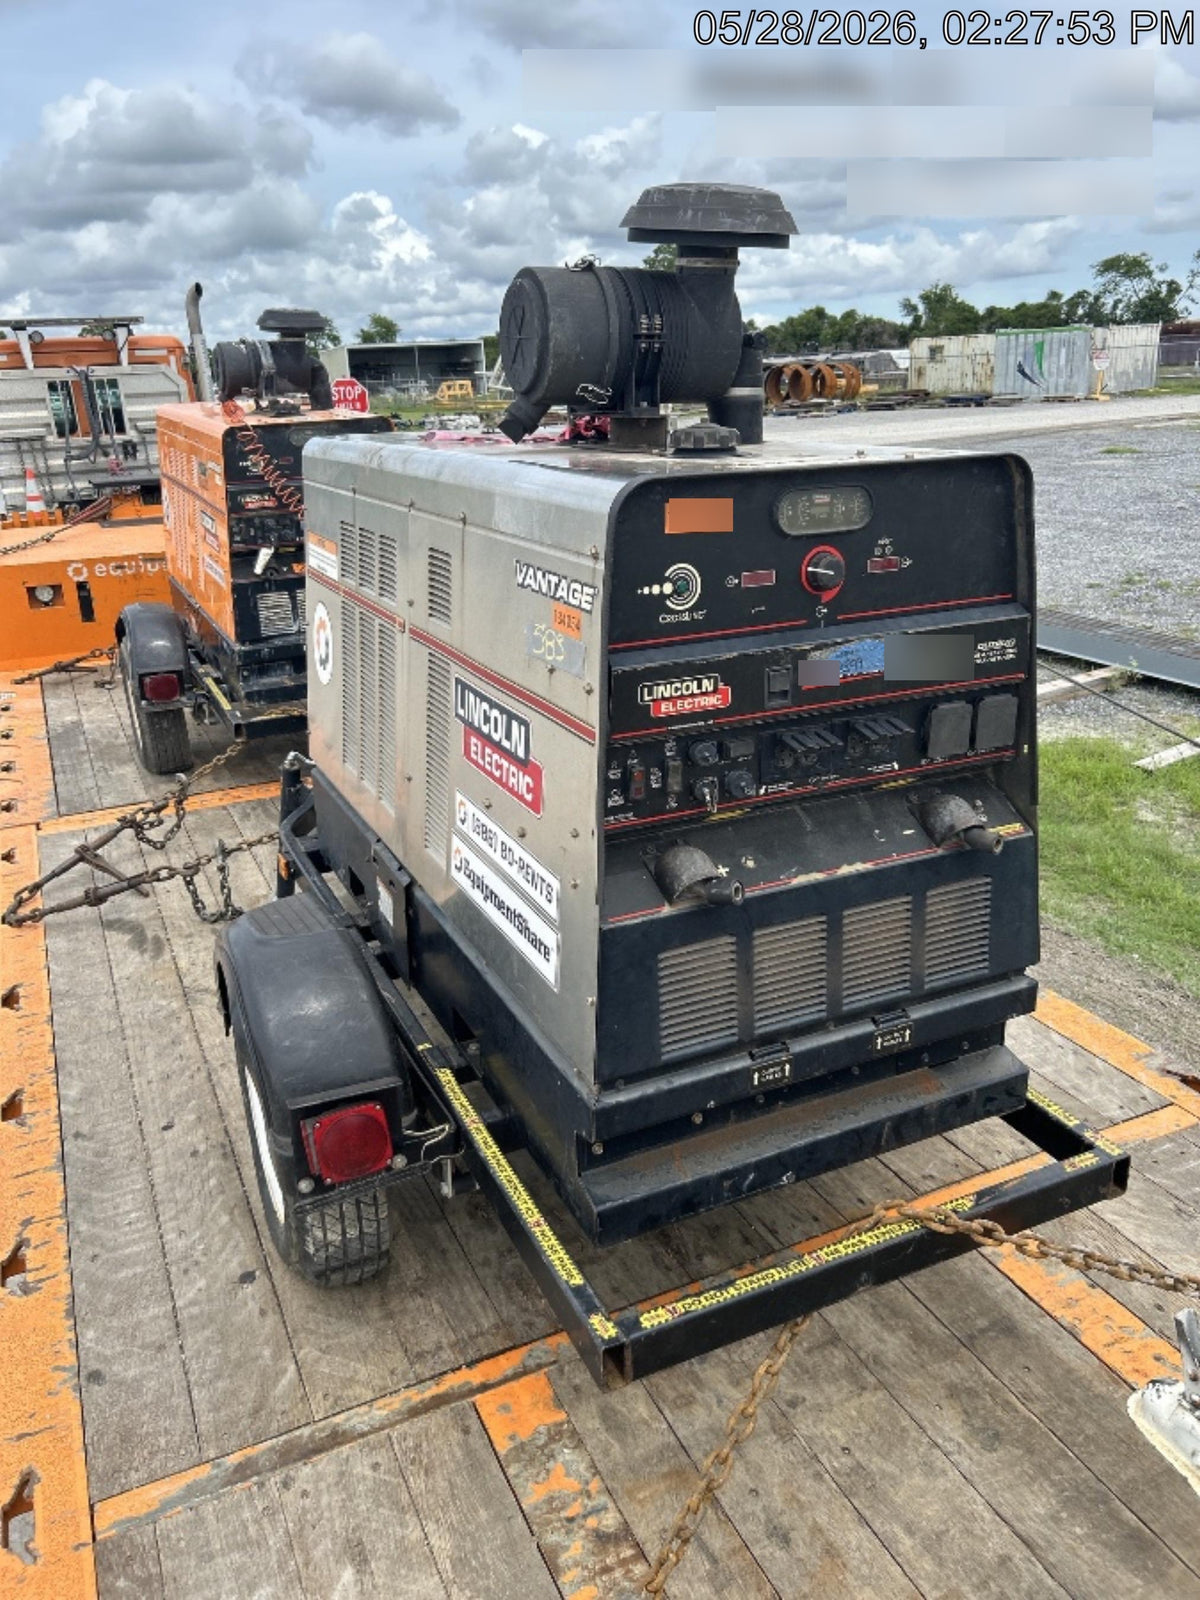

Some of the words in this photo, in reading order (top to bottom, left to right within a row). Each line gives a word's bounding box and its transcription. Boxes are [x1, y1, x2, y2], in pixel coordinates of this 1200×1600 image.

[331, 386, 361, 401] STOP
[515, 561, 594, 612] VANTAGE
[642, 678, 714, 701] LINCOLN
[660, 694, 723, 713] ELECTRIC
[457, 684, 526, 760] LINCOLN
[470, 735, 534, 803] ELECTRIC
[463, 856, 551, 963] EquipmentShare
